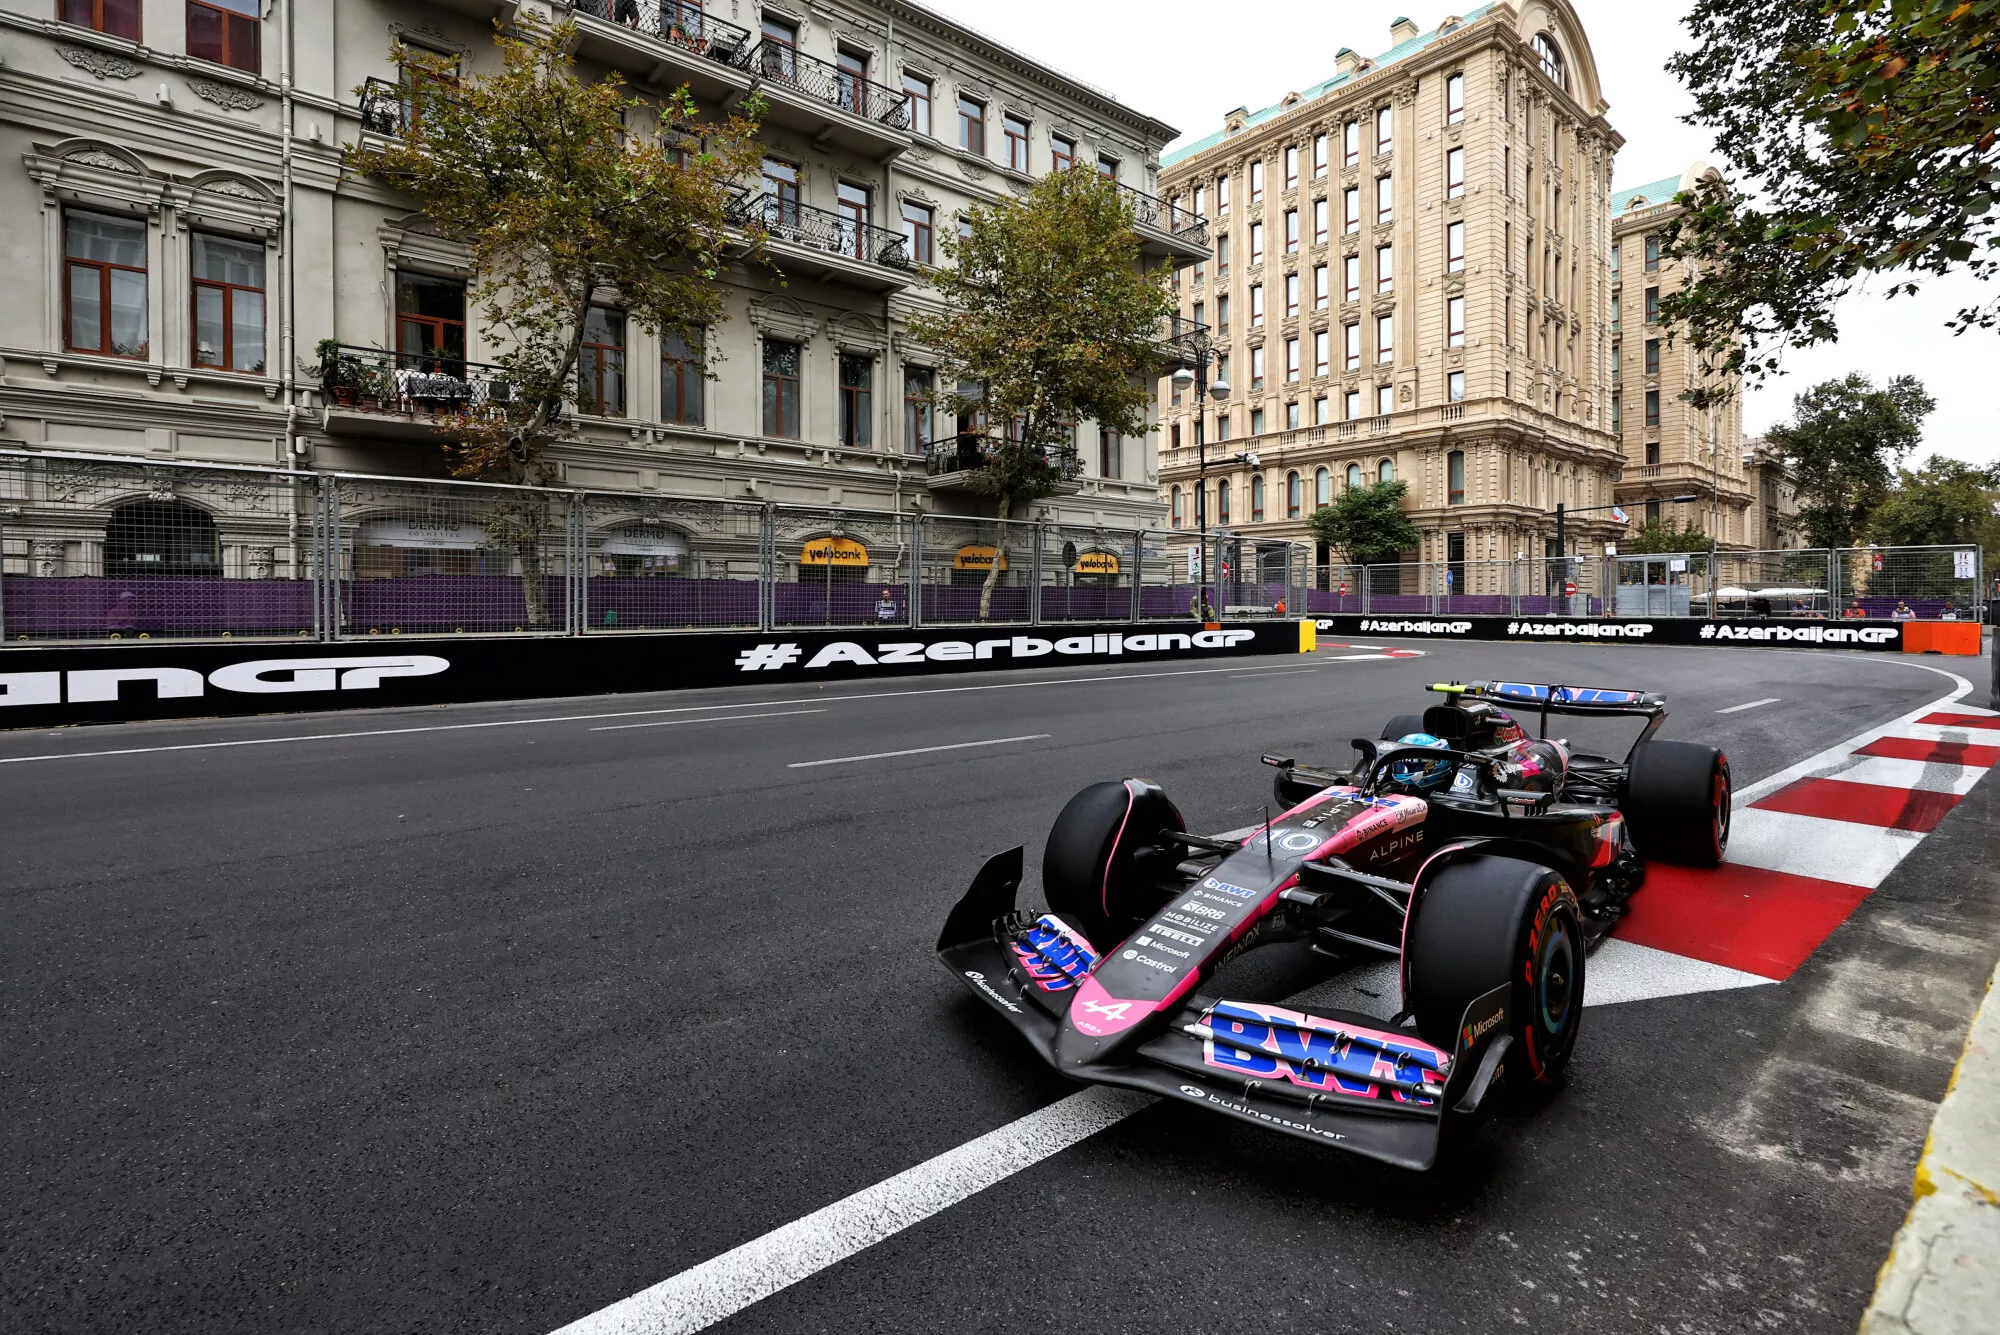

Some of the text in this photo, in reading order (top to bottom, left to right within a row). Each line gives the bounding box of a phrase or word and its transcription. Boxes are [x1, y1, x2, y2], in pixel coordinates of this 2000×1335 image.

[624, 529, 665, 539] DERMO
[1360, 620, 1473, 634] #AzerbaijanGP
[1507, 621, 1654, 637] #AzerbaijanGP
[1700, 624, 1899, 643] #AzerbaijanGP
[735, 629, 1255, 671] #AzerbaijanGP
[1363, 819, 1389, 837] BINANCE
[1369, 830, 1424, 862] ALPINE
[1216, 882, 1257, 898] BWT
[1203, 893, 1244, 908] BINANCE
[1161, 916, 1187, 927] FINANCIAL
[1194, 905, 1226, 919] BRB
[1529, 884, 1558, 956] ZERO
[1148, 923, 1205, 947] PIRELLI
[1150, 940, 1190, 959] Microsoft
[1214, 922, 1260, 974] INFINOX
[1135, 954, 1178, 973] Castrol
[1473, 1007, 1504, 1039] Microsoft
[1203, 1001, 1442, 1105] BWT
[1208, 1093, 1346, 1140] businessolver
